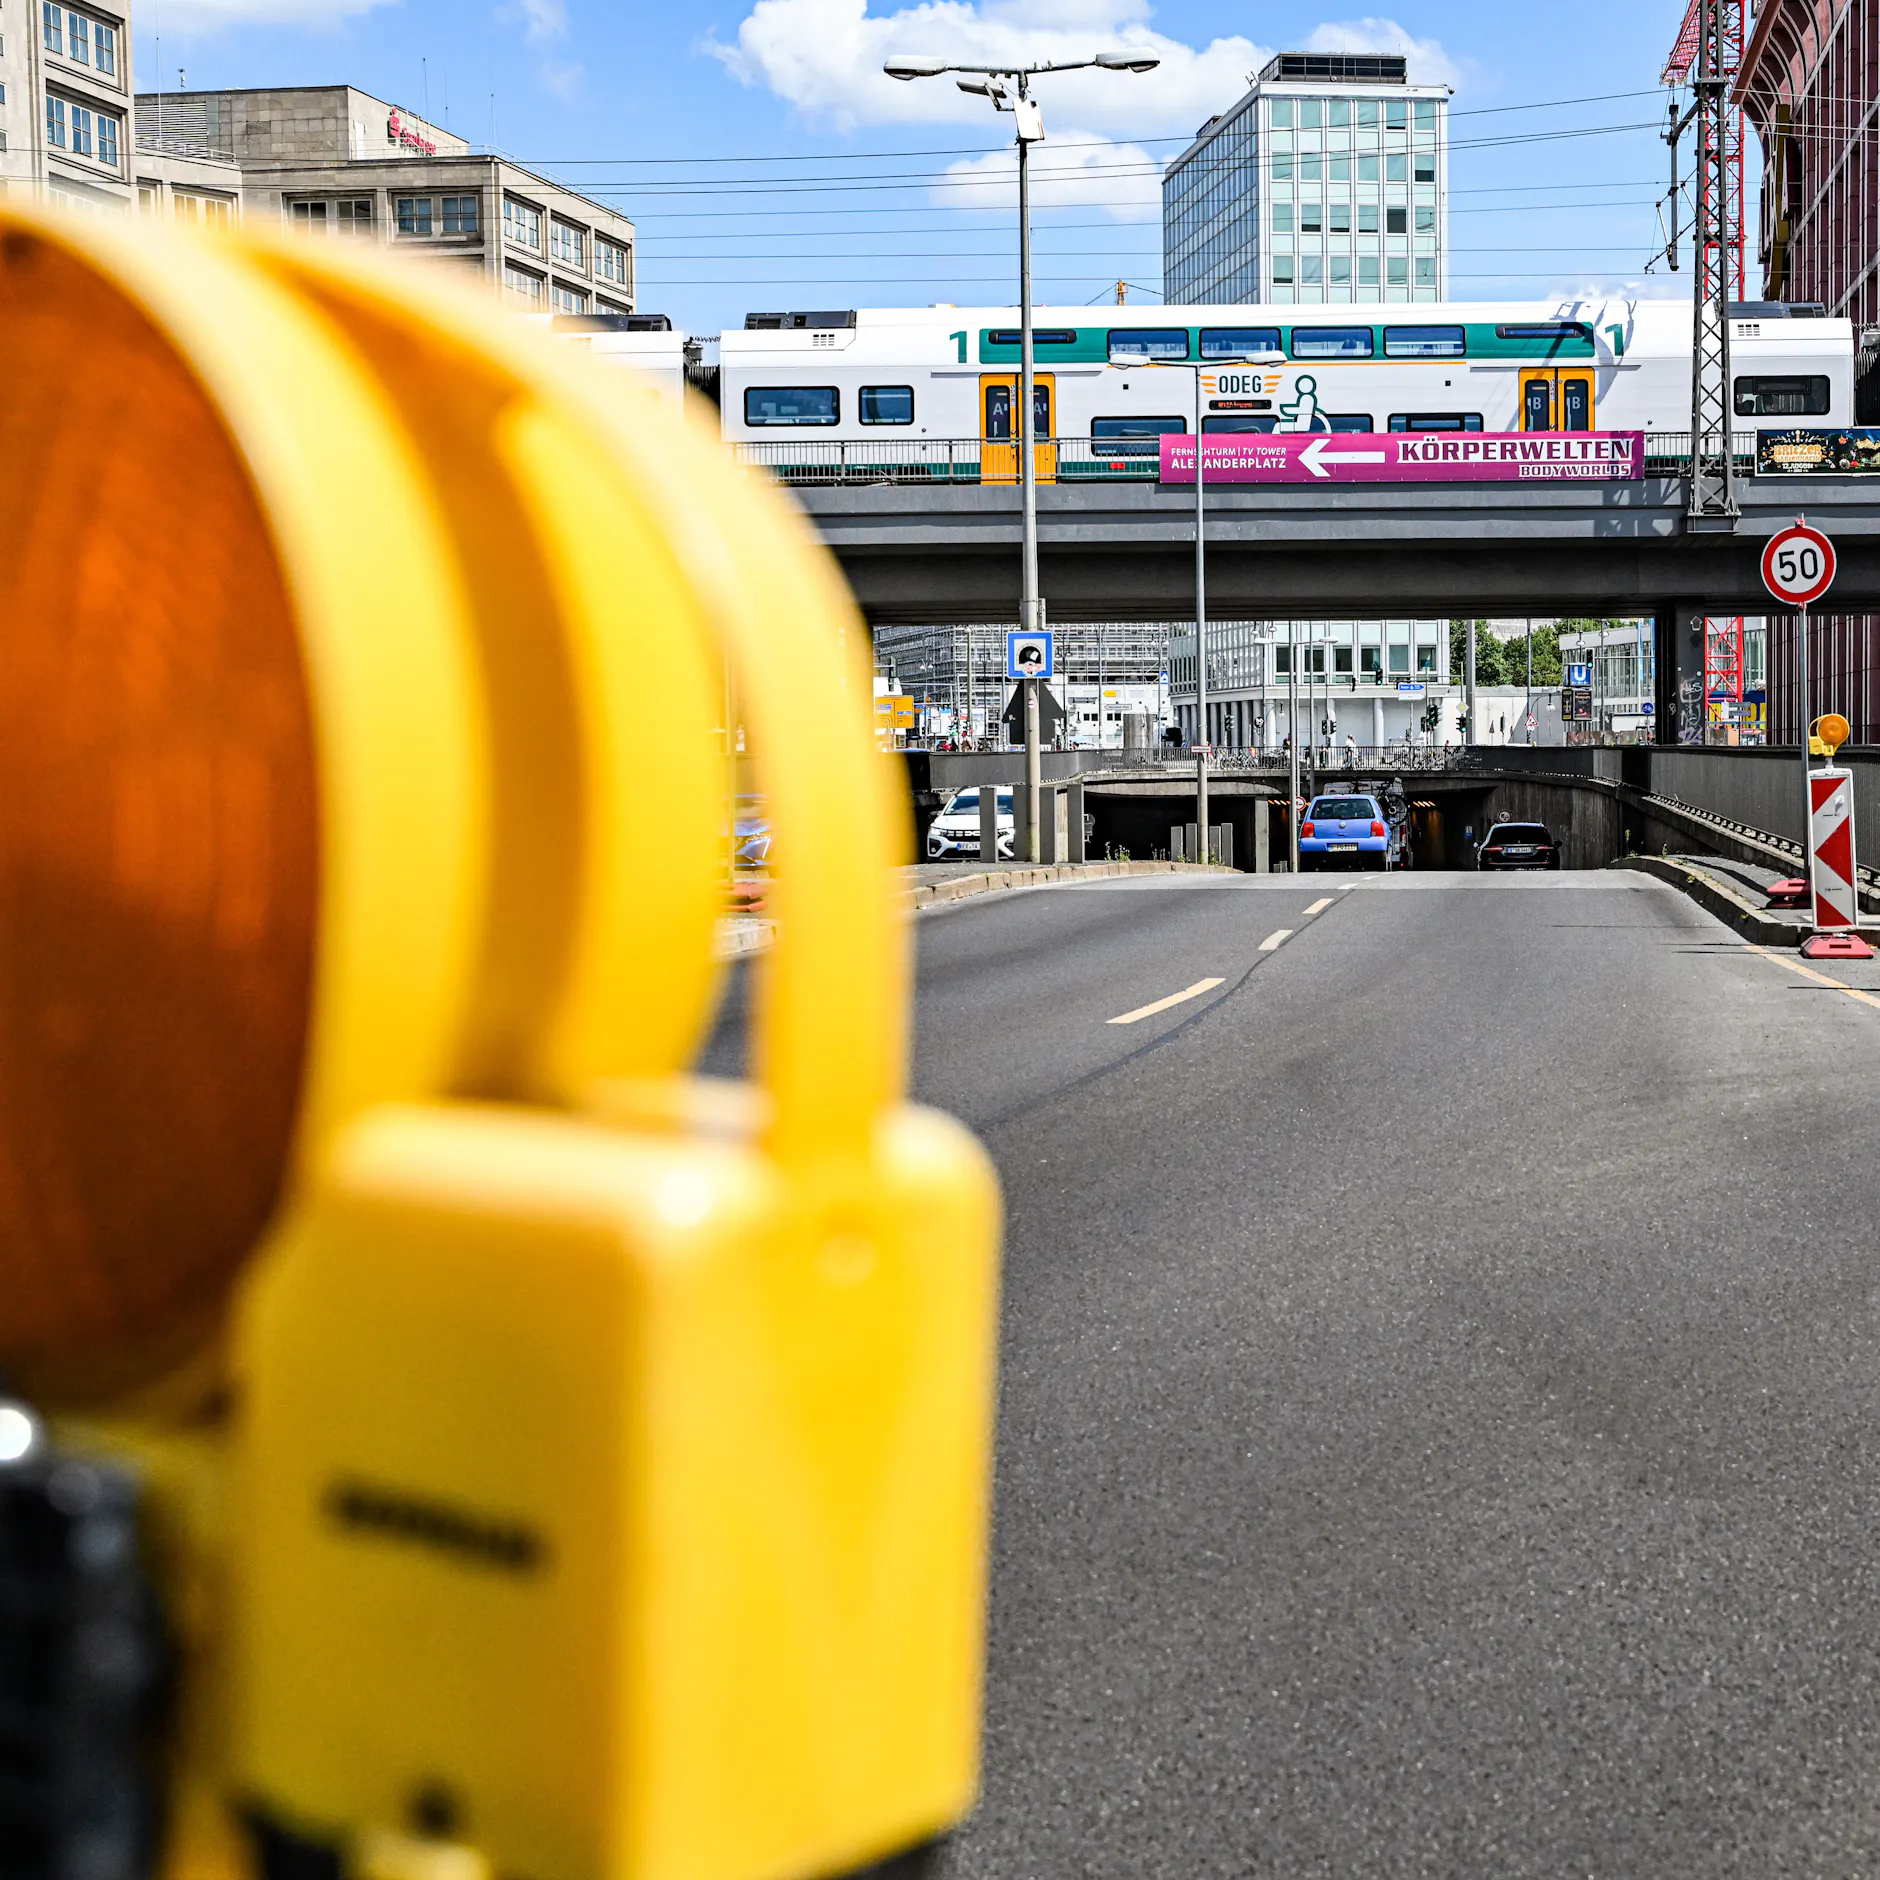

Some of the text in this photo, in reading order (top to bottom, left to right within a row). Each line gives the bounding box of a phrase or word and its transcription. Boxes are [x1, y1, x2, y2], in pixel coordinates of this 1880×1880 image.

[950, 331, 967, 363] 1
[1605, 324, 1624, 356] 1
[1219, 375, 1262, 393] ODEG
[1532, 397, 1542, 410] B
[1572, 397, 1581, 410] B
[1242, 447, 1254, 455] TV
[1256, 447, 1287, 455] TOWER
[1402, 438, 1630, 460] KÖRPERWELTEN
[1171, 458, 1287, 469] ALEANDERPLATZ
[1778, 548, 1818, 582] 50
[1574, 664, 1587, 681] U
